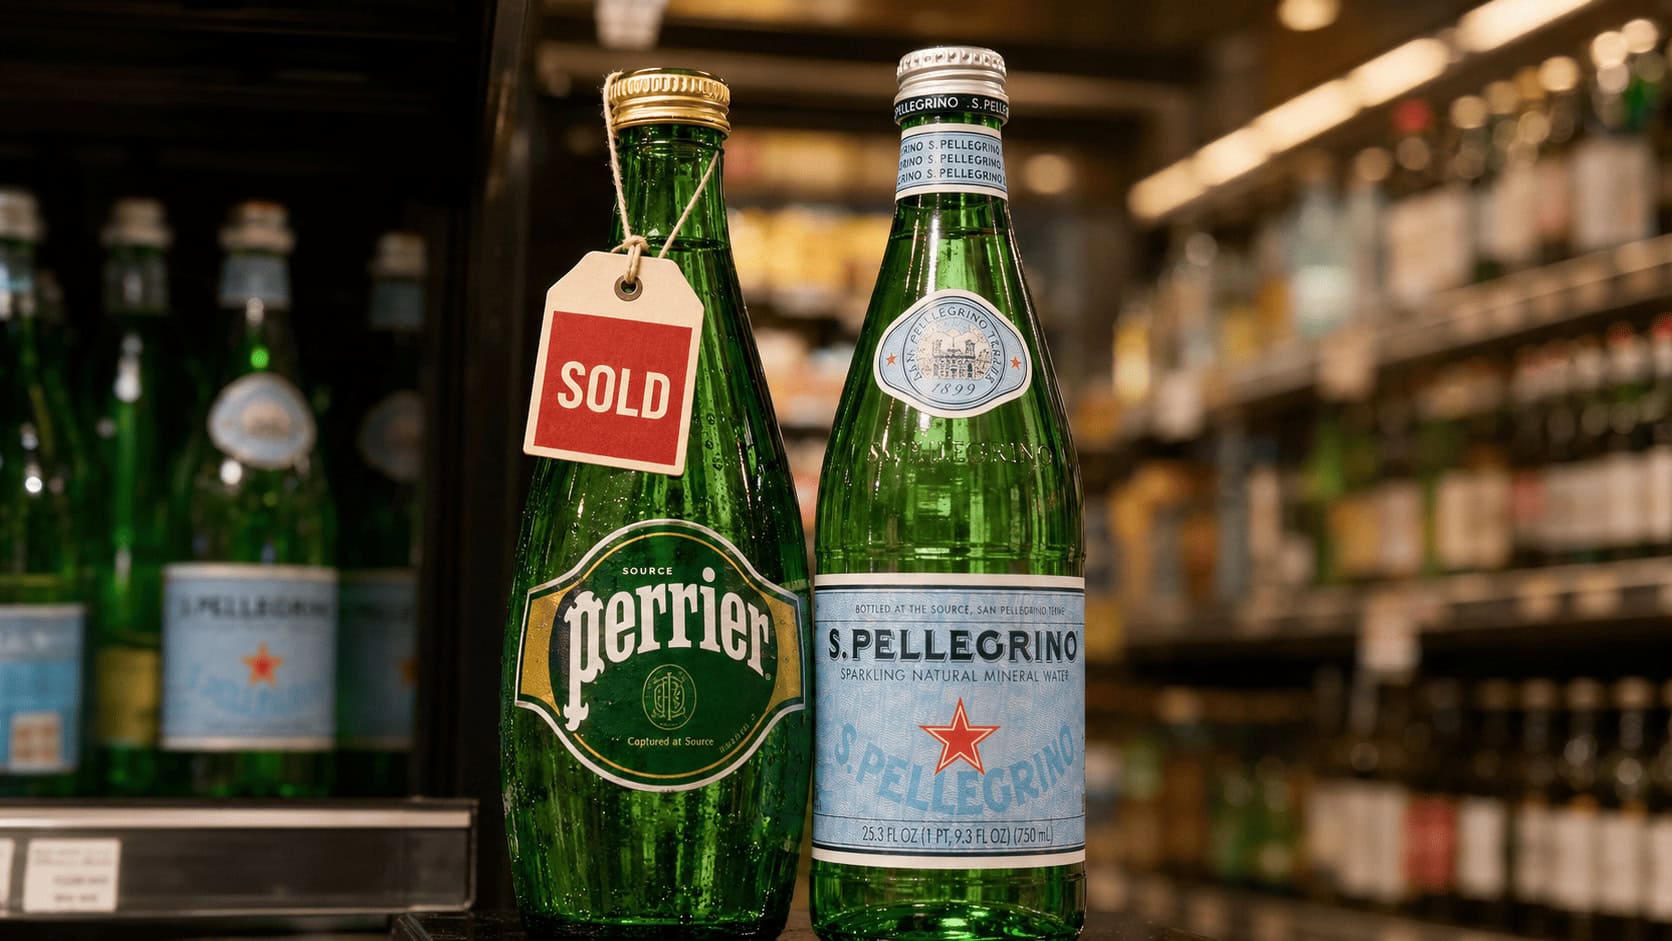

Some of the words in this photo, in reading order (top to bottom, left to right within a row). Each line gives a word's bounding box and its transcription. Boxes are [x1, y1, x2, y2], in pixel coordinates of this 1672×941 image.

[911, 306, 988, 344] PELLEGRINO
[557, 361, 670, 420] SOLD
[932, 383, 976, 396] 1899
[622, 567, 673, 575] SOURCE
[855, 604, 891, 614] BOTTLED
[894, 605, 905, 614] AT
[910, 605, 926, 614] THE
[931, 605, 973, 616] SOURCE,
[977, 605, 996, 615] SAN
[1000, 606, 1047, 616] PELLEGRINO
[563, 567, 769, 731] perrier
[828, 628, 1078, 663] S.PELLEGRINO
[840, 668, 905, 681] SPARKLING
[912, 669, 978, 682] NATURAL
[984, 670, 1038, 682] MINERAL
[672, 737, 681, 746] at
[685, 736, 714, 746] Source
[834, 723, 1074, 816] S.PELLEGRINO
[862, 825, 884, 842] 25.3
[887, 827, 898, 842] FL
[900, 828, 917, 844] OZ
[921, 828, 931, 846] (1
[936, 828, 952, 846] PT,
[954, 828, 973, 845] 9.3
[976, 828, 988, 845] FL
[990, 827, 1010, 845] OZ)
[1013, 826, 1036, 845] (750
[1038, 826, 1053, 844] mL)
